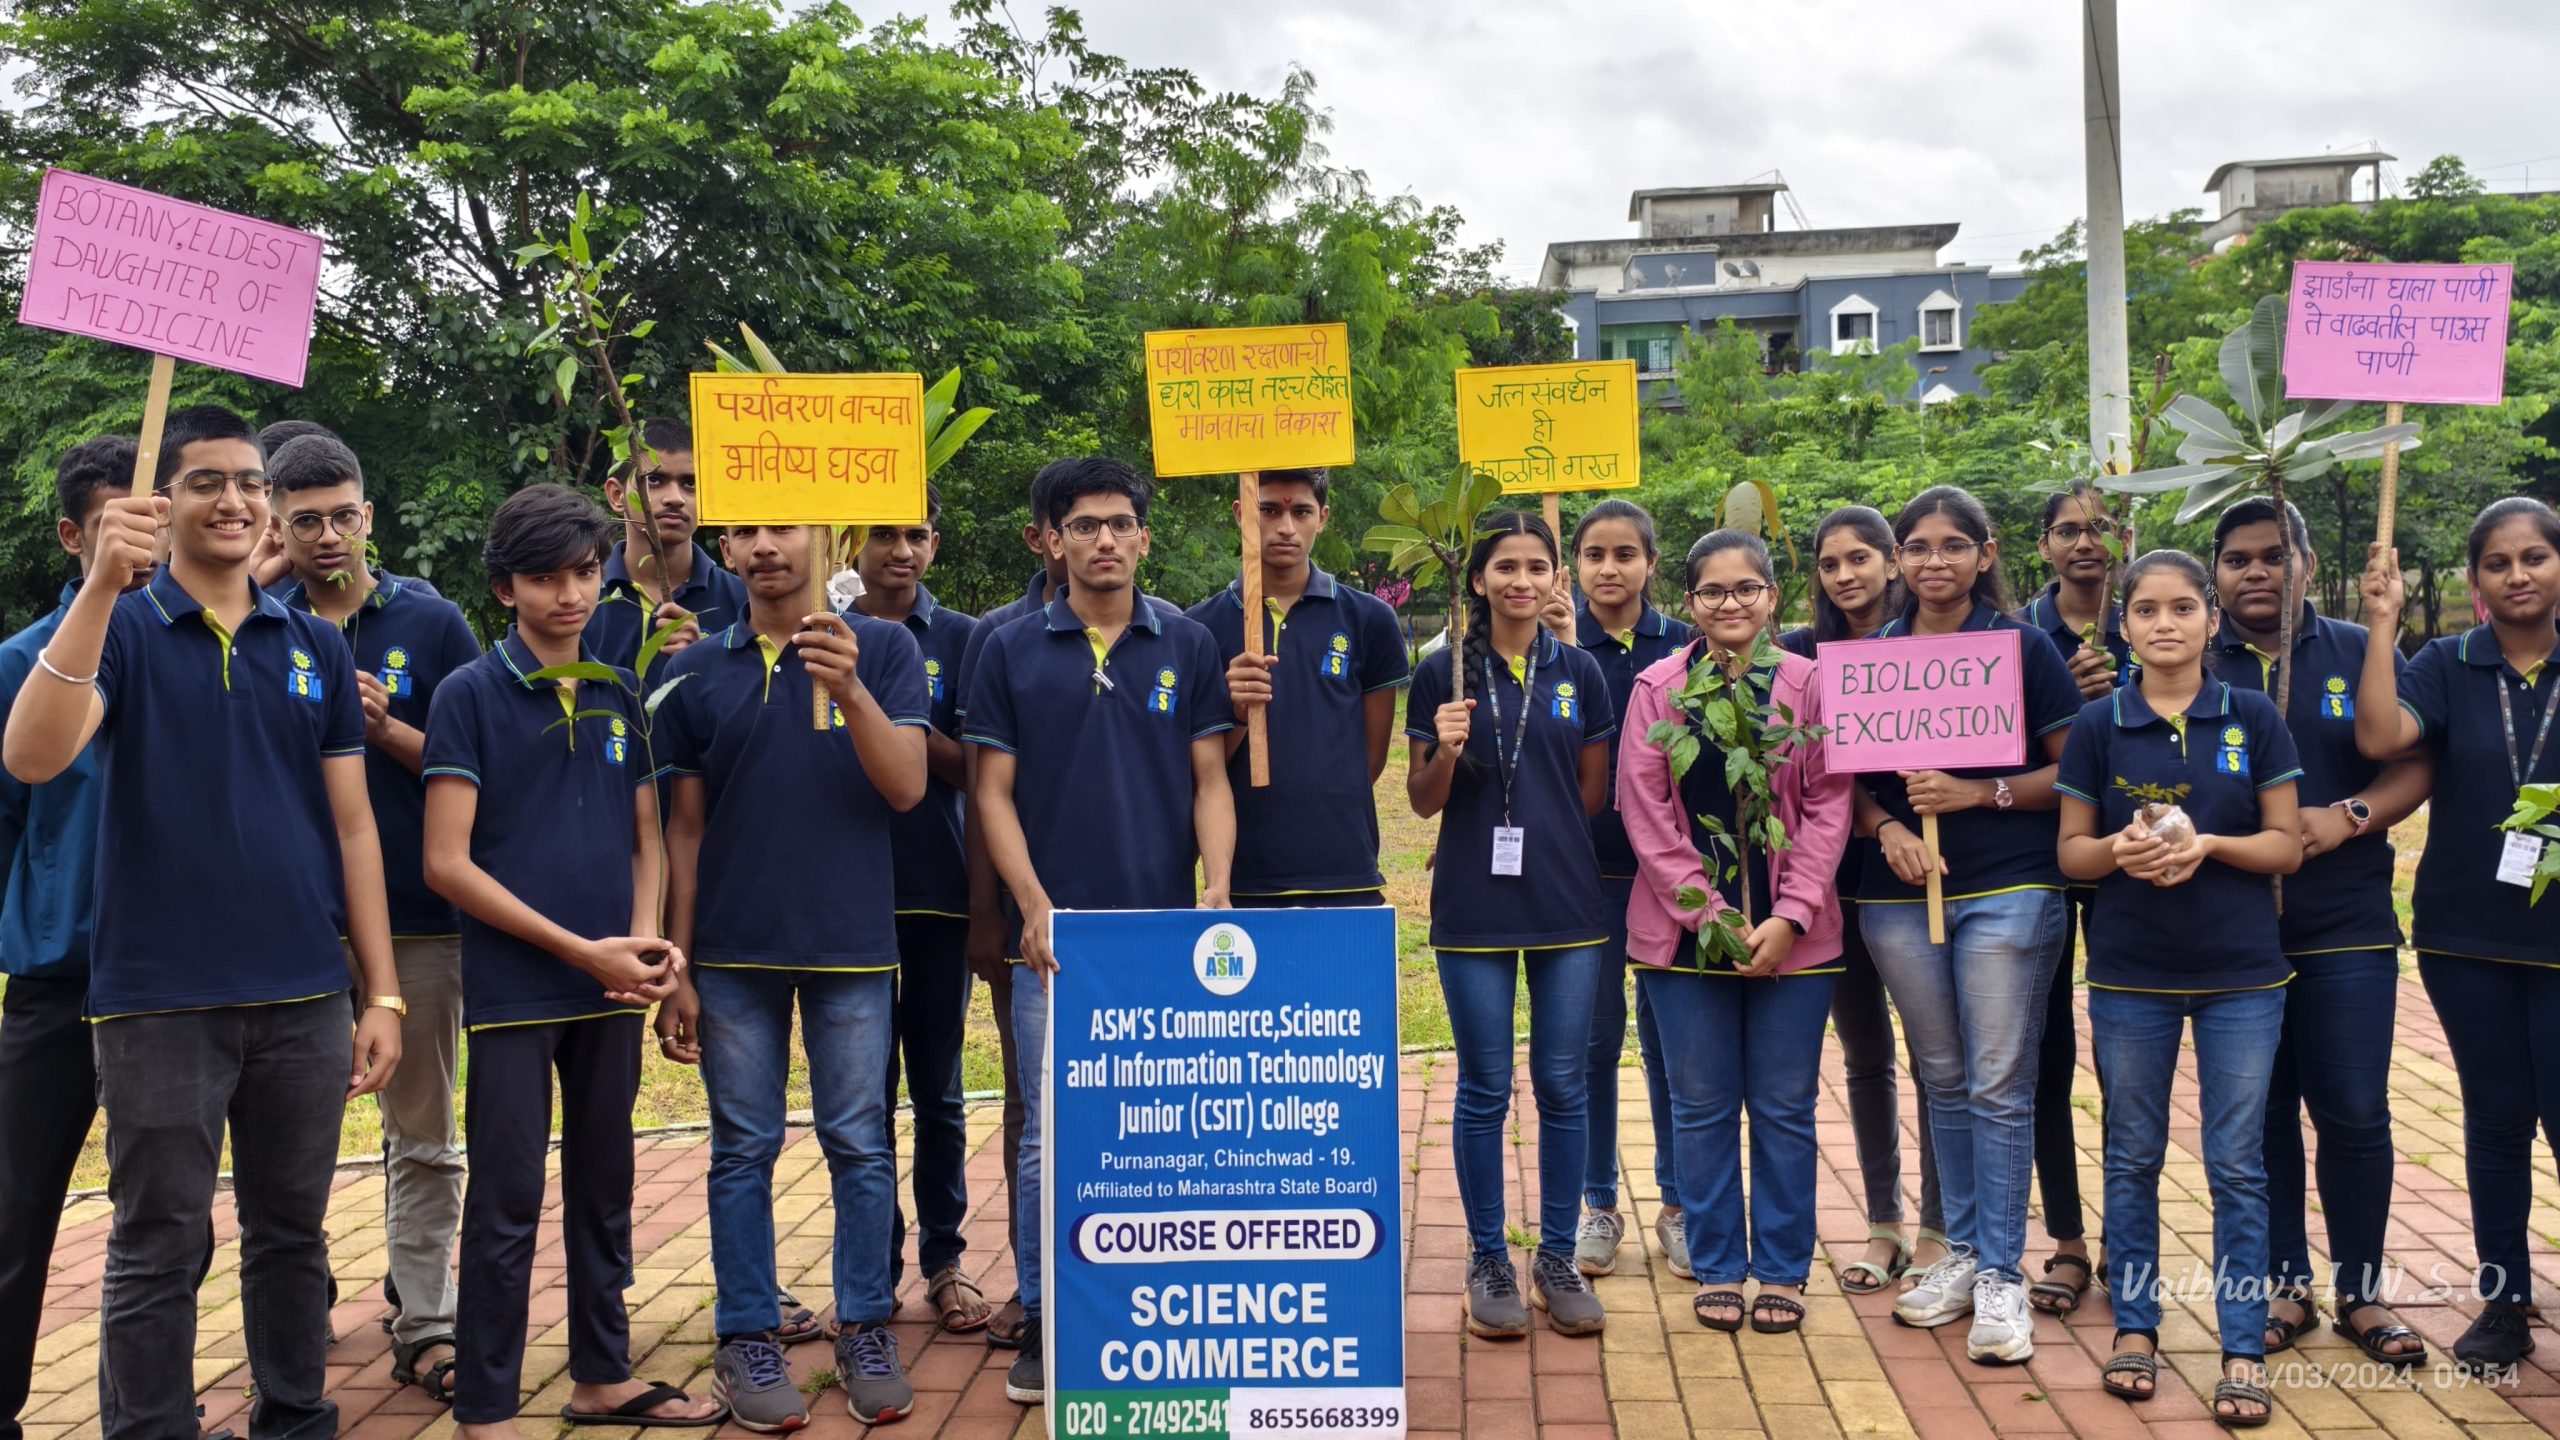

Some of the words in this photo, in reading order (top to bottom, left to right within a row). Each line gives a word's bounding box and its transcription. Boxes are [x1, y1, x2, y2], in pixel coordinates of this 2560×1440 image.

[52, 235, 219, 304] DAUGHTER
[238, 280, 282, 313] OF
[2303, 271, 2380, 301] झाडांना
[2387, 279, 2437, 302] घाला
[2444, 267, 2499, 303] पाणी
[58, 286, 263, 361] MEDICINE
[2305, 302, 2332, 336] ते
[2330, 304, 2427, 340] वाढवतील
[2430, 316, 2491, 342] पाऊस
[1152, 335, 1237, 376] पर्यावरण
[2355, 341, 2420, 376] पाणी
[713, 378, 834, 424] पर्यावरण
[840, 396, 912, 426] वाचवा
[1207, 378, 1255, 408] कास
[1261, 376, 1306, 401] तरच
[1175, 413, 1265, 440] मानवाचा
[1274, 404, 1341, 438] विकास
[720, 430, 817, 483] भविष्य
[828, 447, 900, 484] घडवा
[1562, 453, 1620, 481] गरज
[288, 671, 322, 700] ASM
[1842, 656, 2002, 695] BIOLOGY
[1835, 703, 2014, 745] EXCURSION
[1205, 956, 1243, 976] ASM
[1090, 1007, 1155, 1041] ASM'S
[1067, 1054, 1107, 1087] and
[1113, 1050, 1242, 1086] Information
[1248, 1049, 1385, 1089] Techonology
[1119, 1098, 1184, 1140] Junior
[1191, 1091, 1254, 1139] (CSIT)
[1261, 1096, 1339, 1136] College
[1101, 1151, 1208, 1172] Purnanagar,
[1214, 1148, 1313, 1168] Chinchwad
[1330, 1148, 1355, 1166] 19.
[1077, 1181, 1153, 1201] (Affiliated
[1157, 1182, 1173, 1197] to
[1178, 1179, 1275, 1196] Maharashtra
[1280, 1178, 1320, 1195] State
[1325, 1177, 1378, 1197] Board)
[1095, 1220, 1216, 1253] COURSE
[1226, 1219, 1361, 1251] OFFERED
[1131, 1283, 1328, 1327] SCIENCE
[1100, 1337, 1360, 1382] COMMERCE
[1066, 1402, 1107, 1435] 020
[1249, 1407, 1400, 1429] 8655668399
